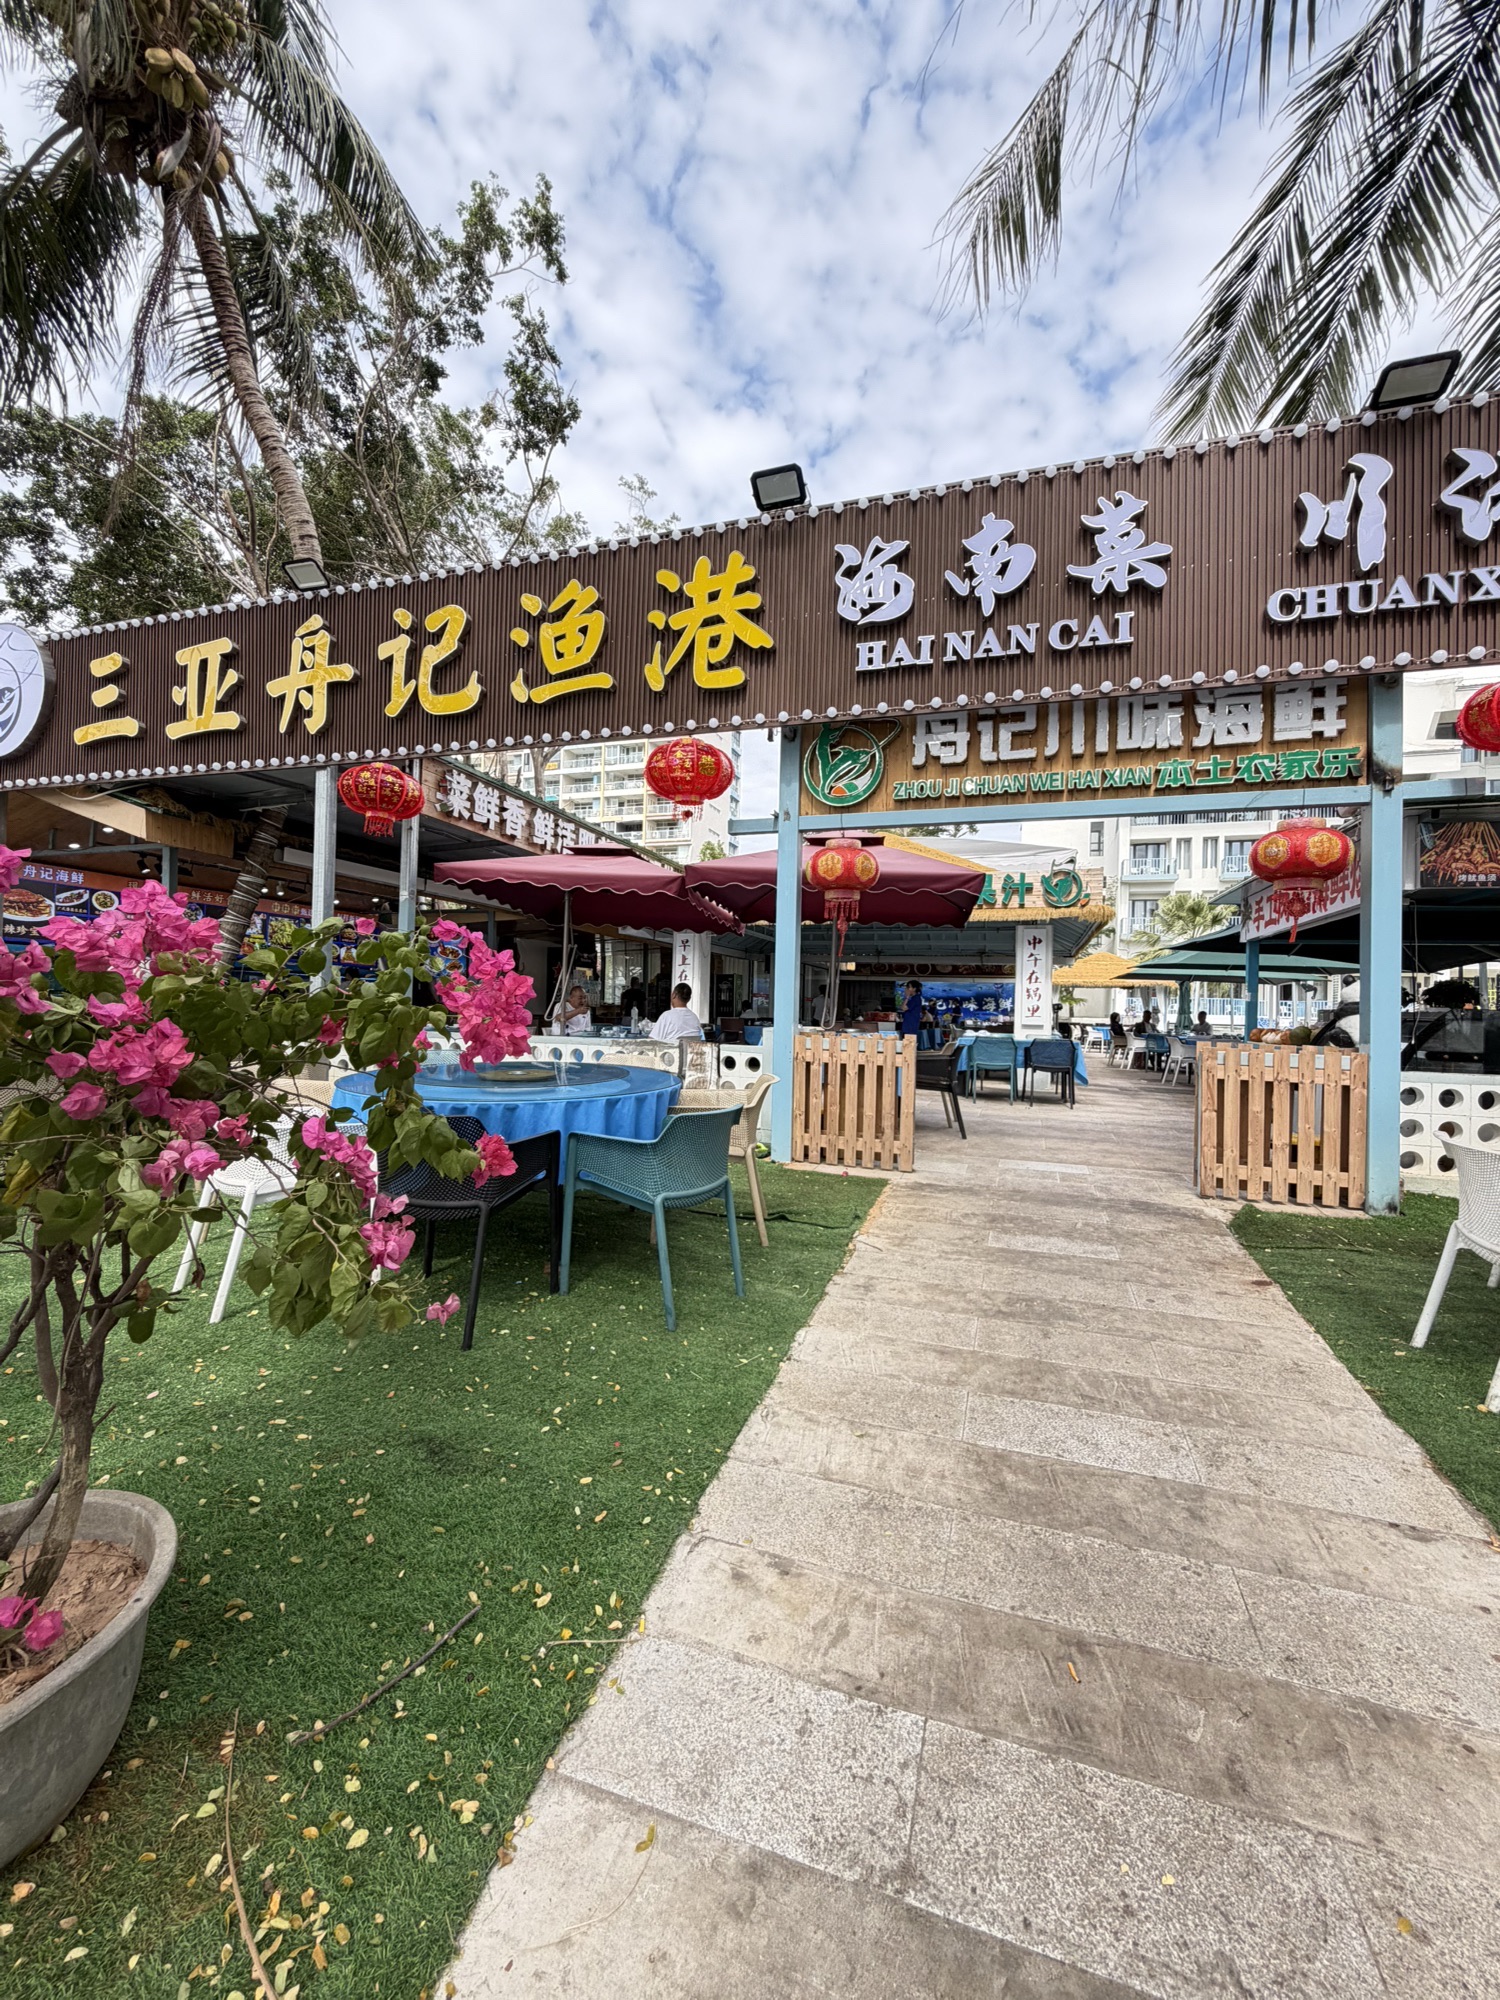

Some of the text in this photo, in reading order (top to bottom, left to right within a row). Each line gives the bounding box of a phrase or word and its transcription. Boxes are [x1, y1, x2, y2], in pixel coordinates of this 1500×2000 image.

[835, 491, 1173, 625] 海南菜
[74, 550, 774, 746] 三亚舟记渔港
[856, 611, 1135, 671] HAI NAN CAI
[893, 765, 1153, 800] ZHOU JI CHUAN WEI HAI XIAN
[1156, 746, 1363, 787] 本土农家乐
[23, 865, 85, 884] 舟记海鲜
[678, 938, 691, 982] 早上在
[1025, 935, 1043, 1018] 中午在锅里
